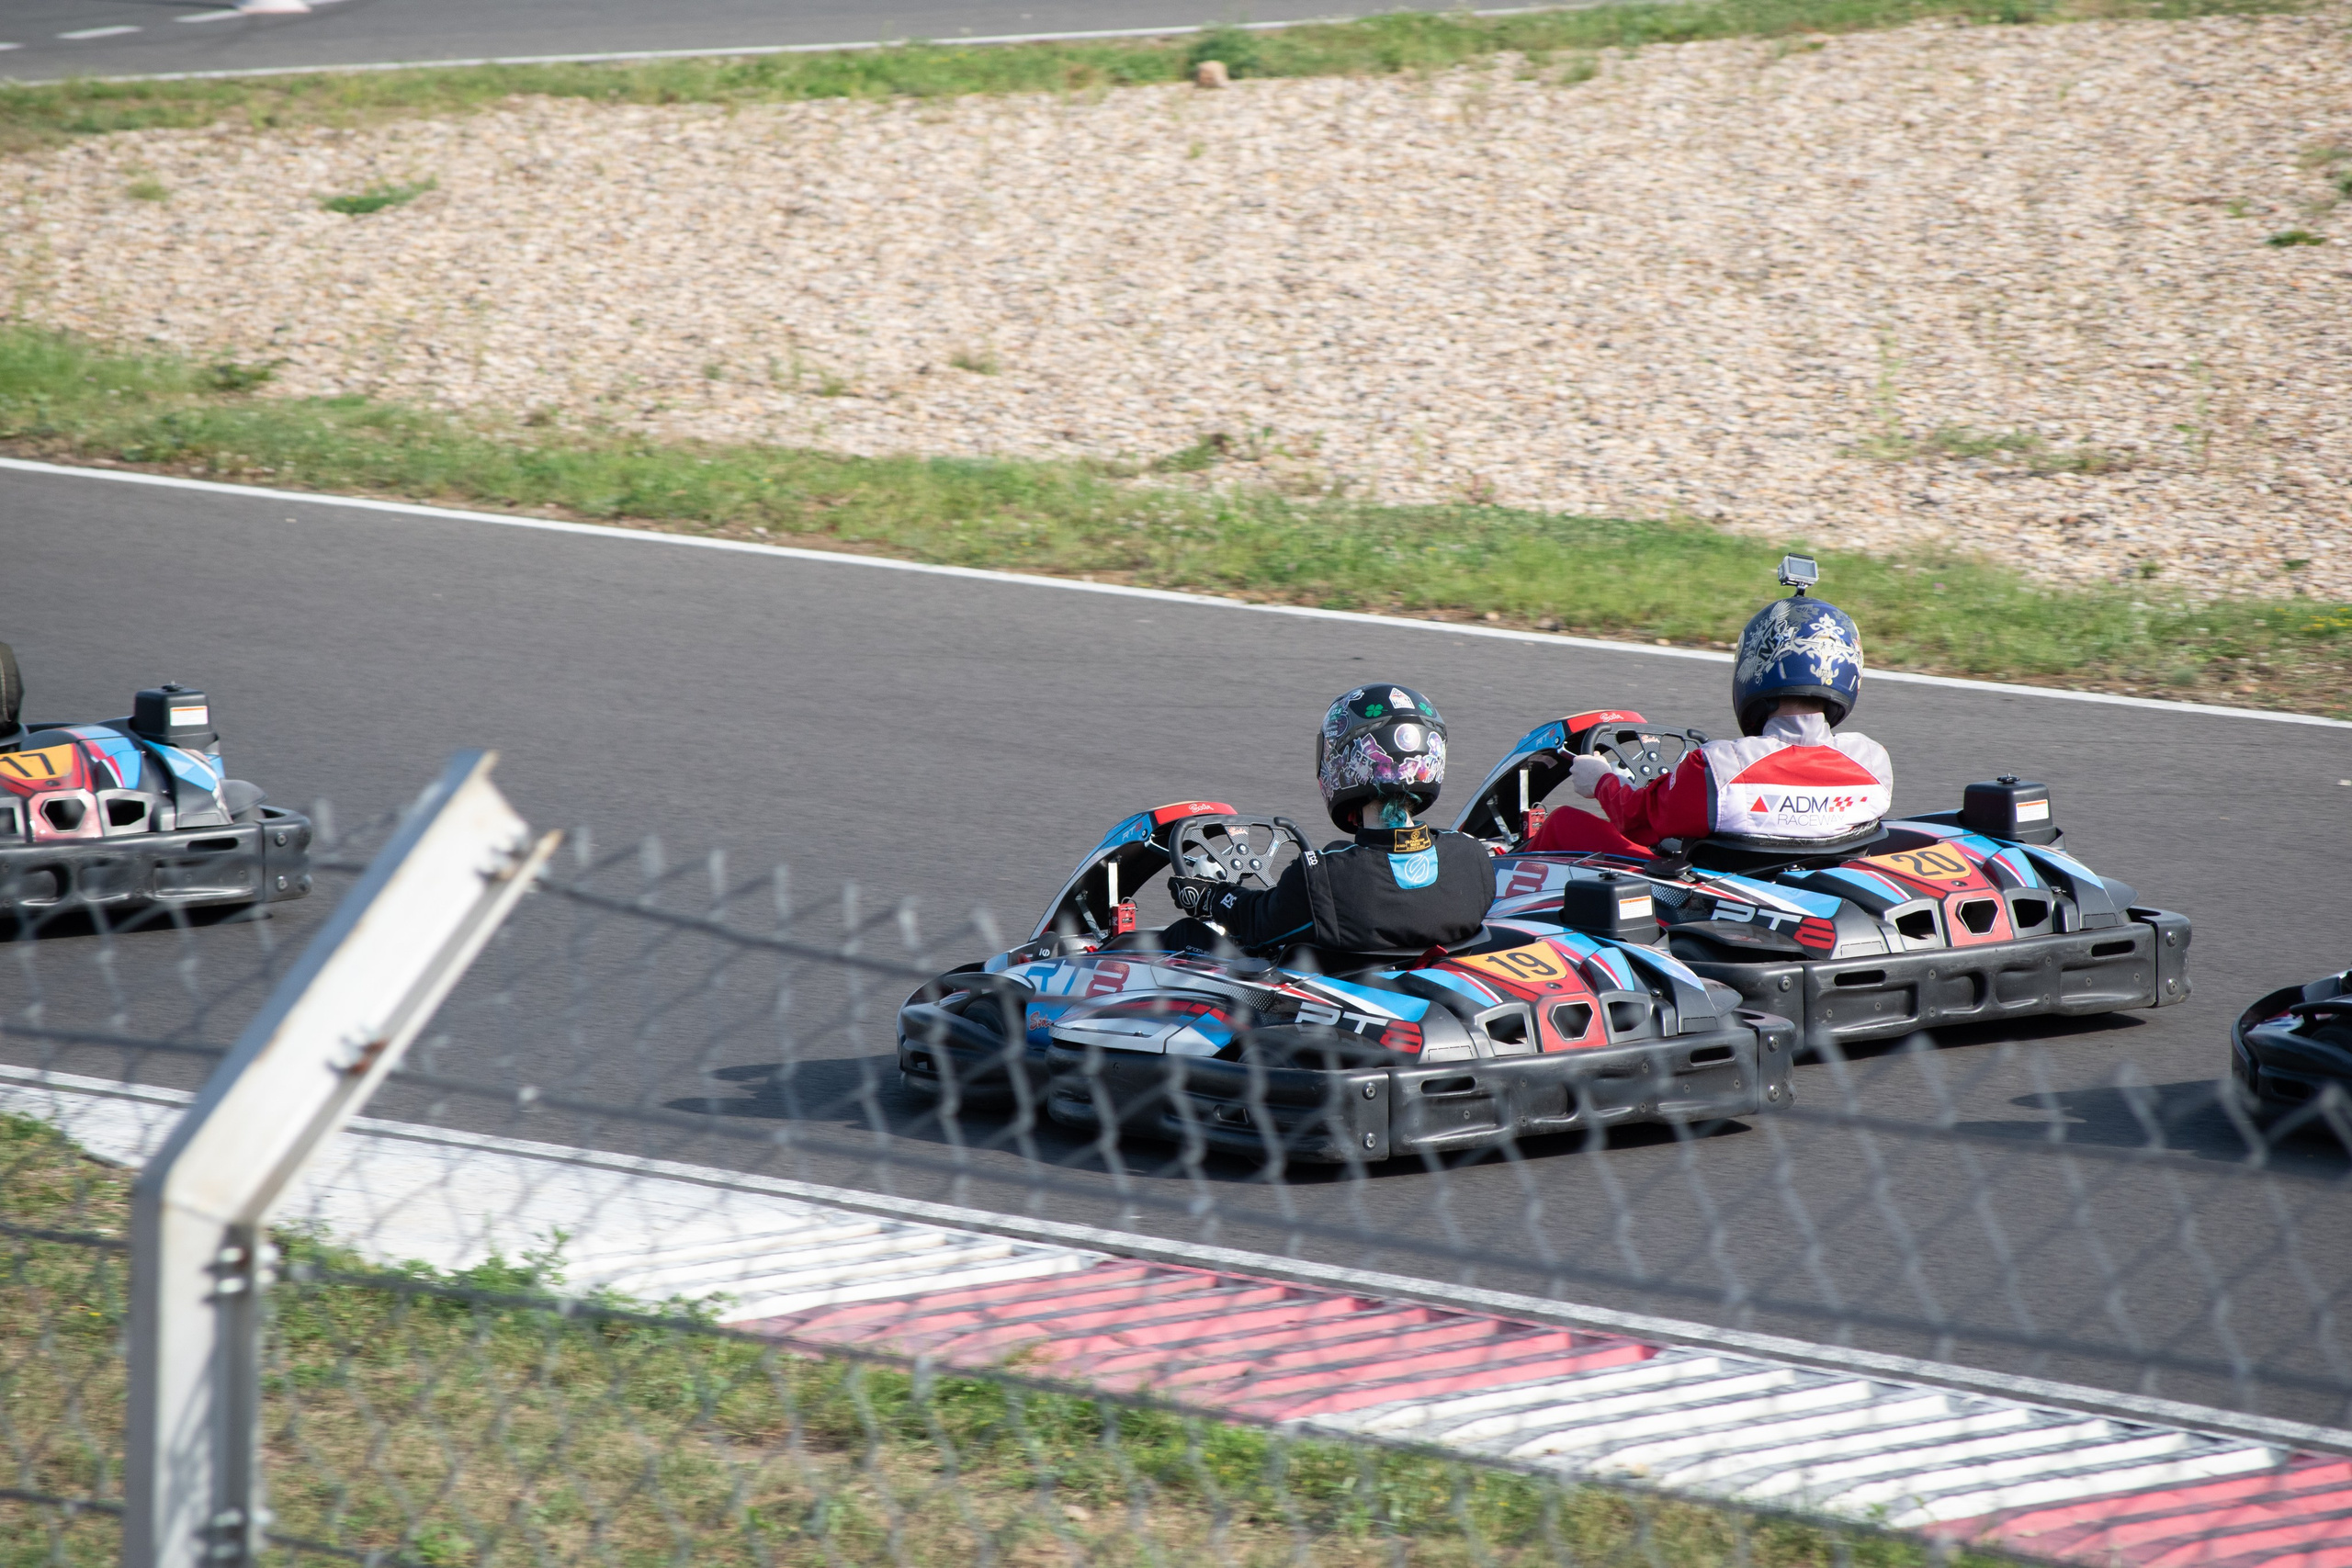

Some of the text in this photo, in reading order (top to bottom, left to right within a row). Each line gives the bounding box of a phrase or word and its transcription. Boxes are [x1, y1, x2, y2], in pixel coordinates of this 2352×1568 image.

[0, 753, 56, 777] 17
[1779, 795, 1829, 814] ADM
[1777, 813, 1845, 827] RACEWAY
[1890, 851, 1966, 876] 20
[1485, 953, 1557, 979] 19
[1024, 960, 1130, 998] RT8
